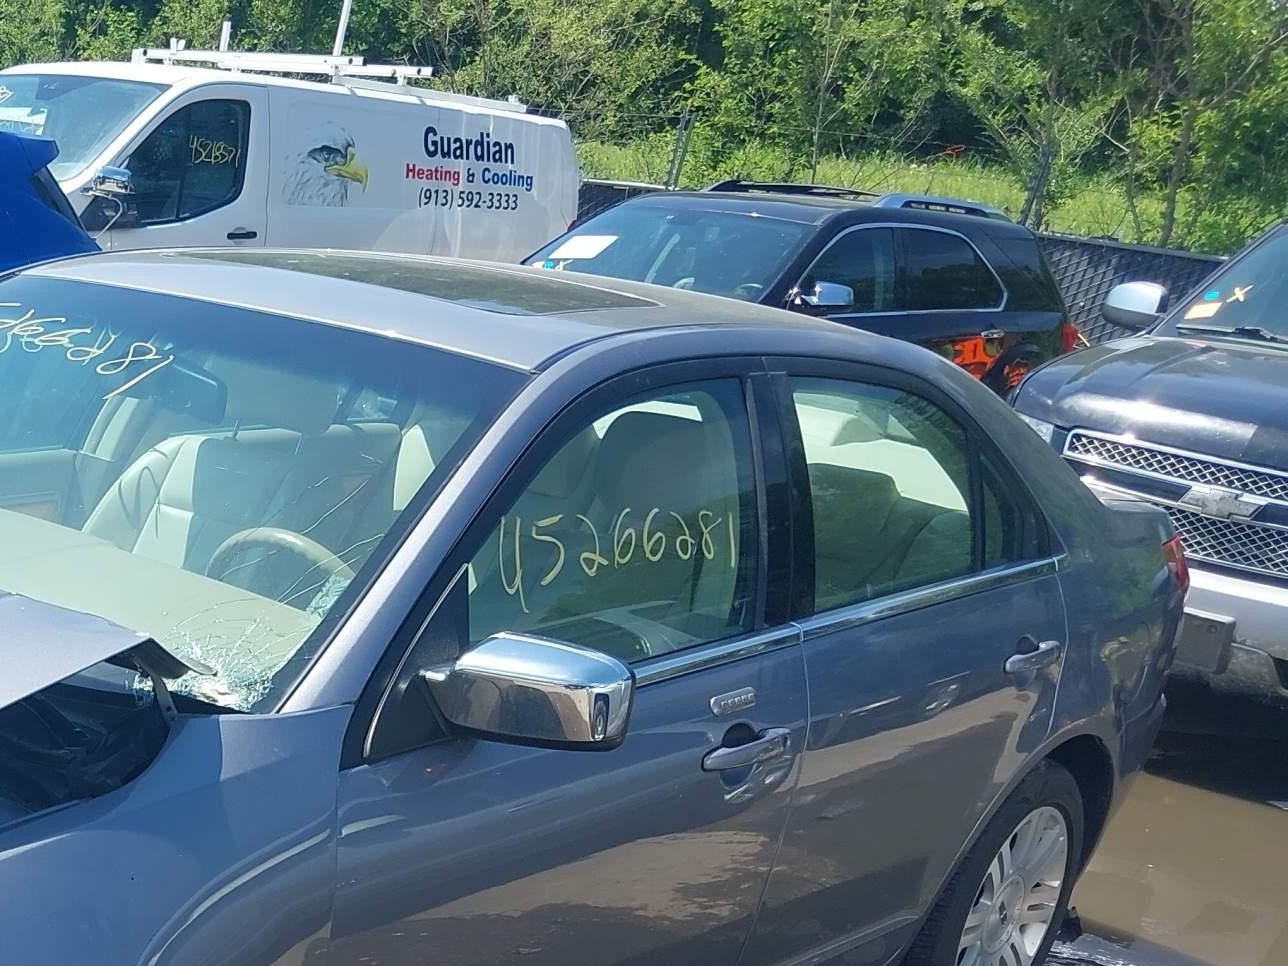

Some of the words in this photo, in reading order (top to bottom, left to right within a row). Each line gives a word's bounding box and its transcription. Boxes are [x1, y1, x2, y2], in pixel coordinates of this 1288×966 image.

[423, 126, 515, 165] Guardian
[405, 163, 461, 187] Heating
[466, 167, 475, 183] &
[481, 167, 534, 192] Cooling
[418, 187, 454, 210] (913)
[457, 190, 519, 211] 592-3333
[500, 507, 736, 613] 45266281
